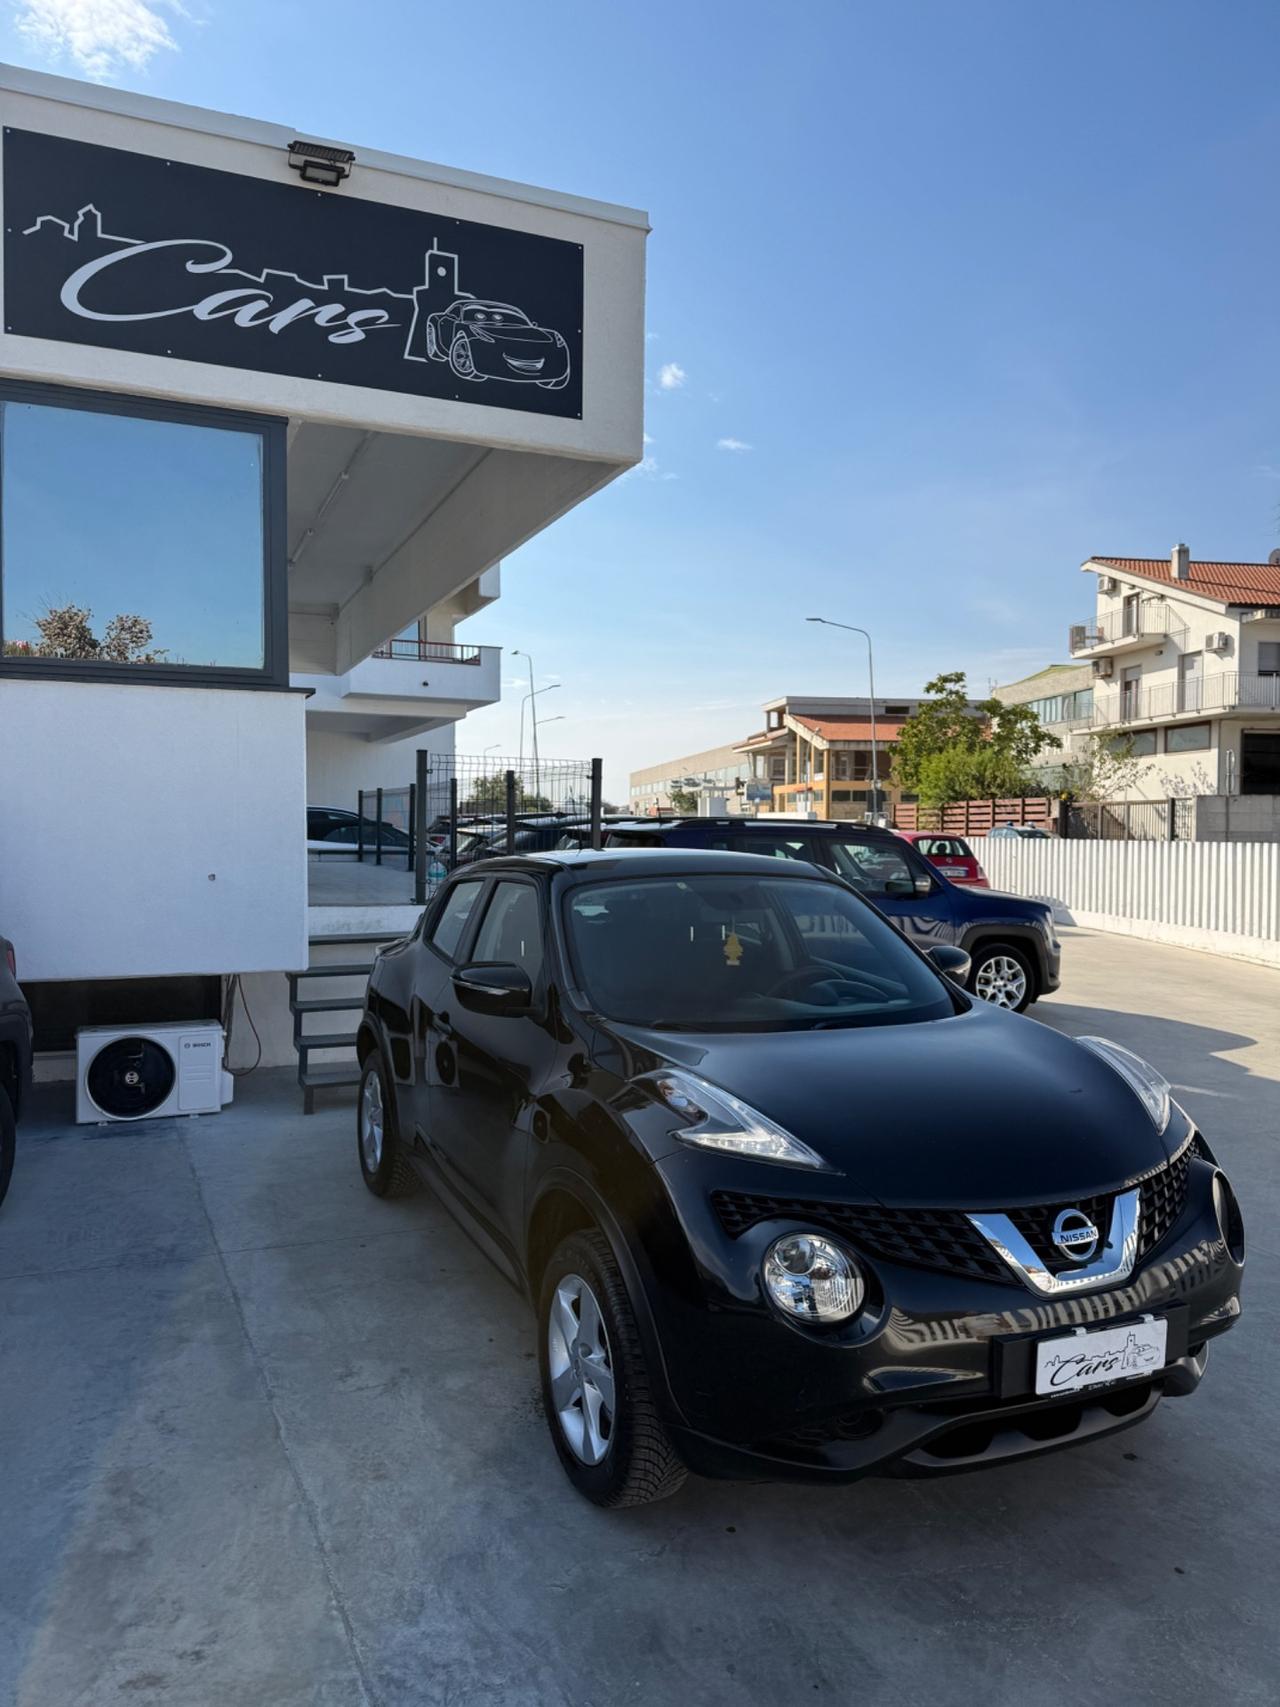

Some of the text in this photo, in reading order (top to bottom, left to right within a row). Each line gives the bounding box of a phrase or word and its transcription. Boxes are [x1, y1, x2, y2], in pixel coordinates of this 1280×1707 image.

[60, 239, 402, 344] Cars
[1060, 1230, 1097, 1242] NISSAN
[1050, 1353, 1119, 1386] Cars
